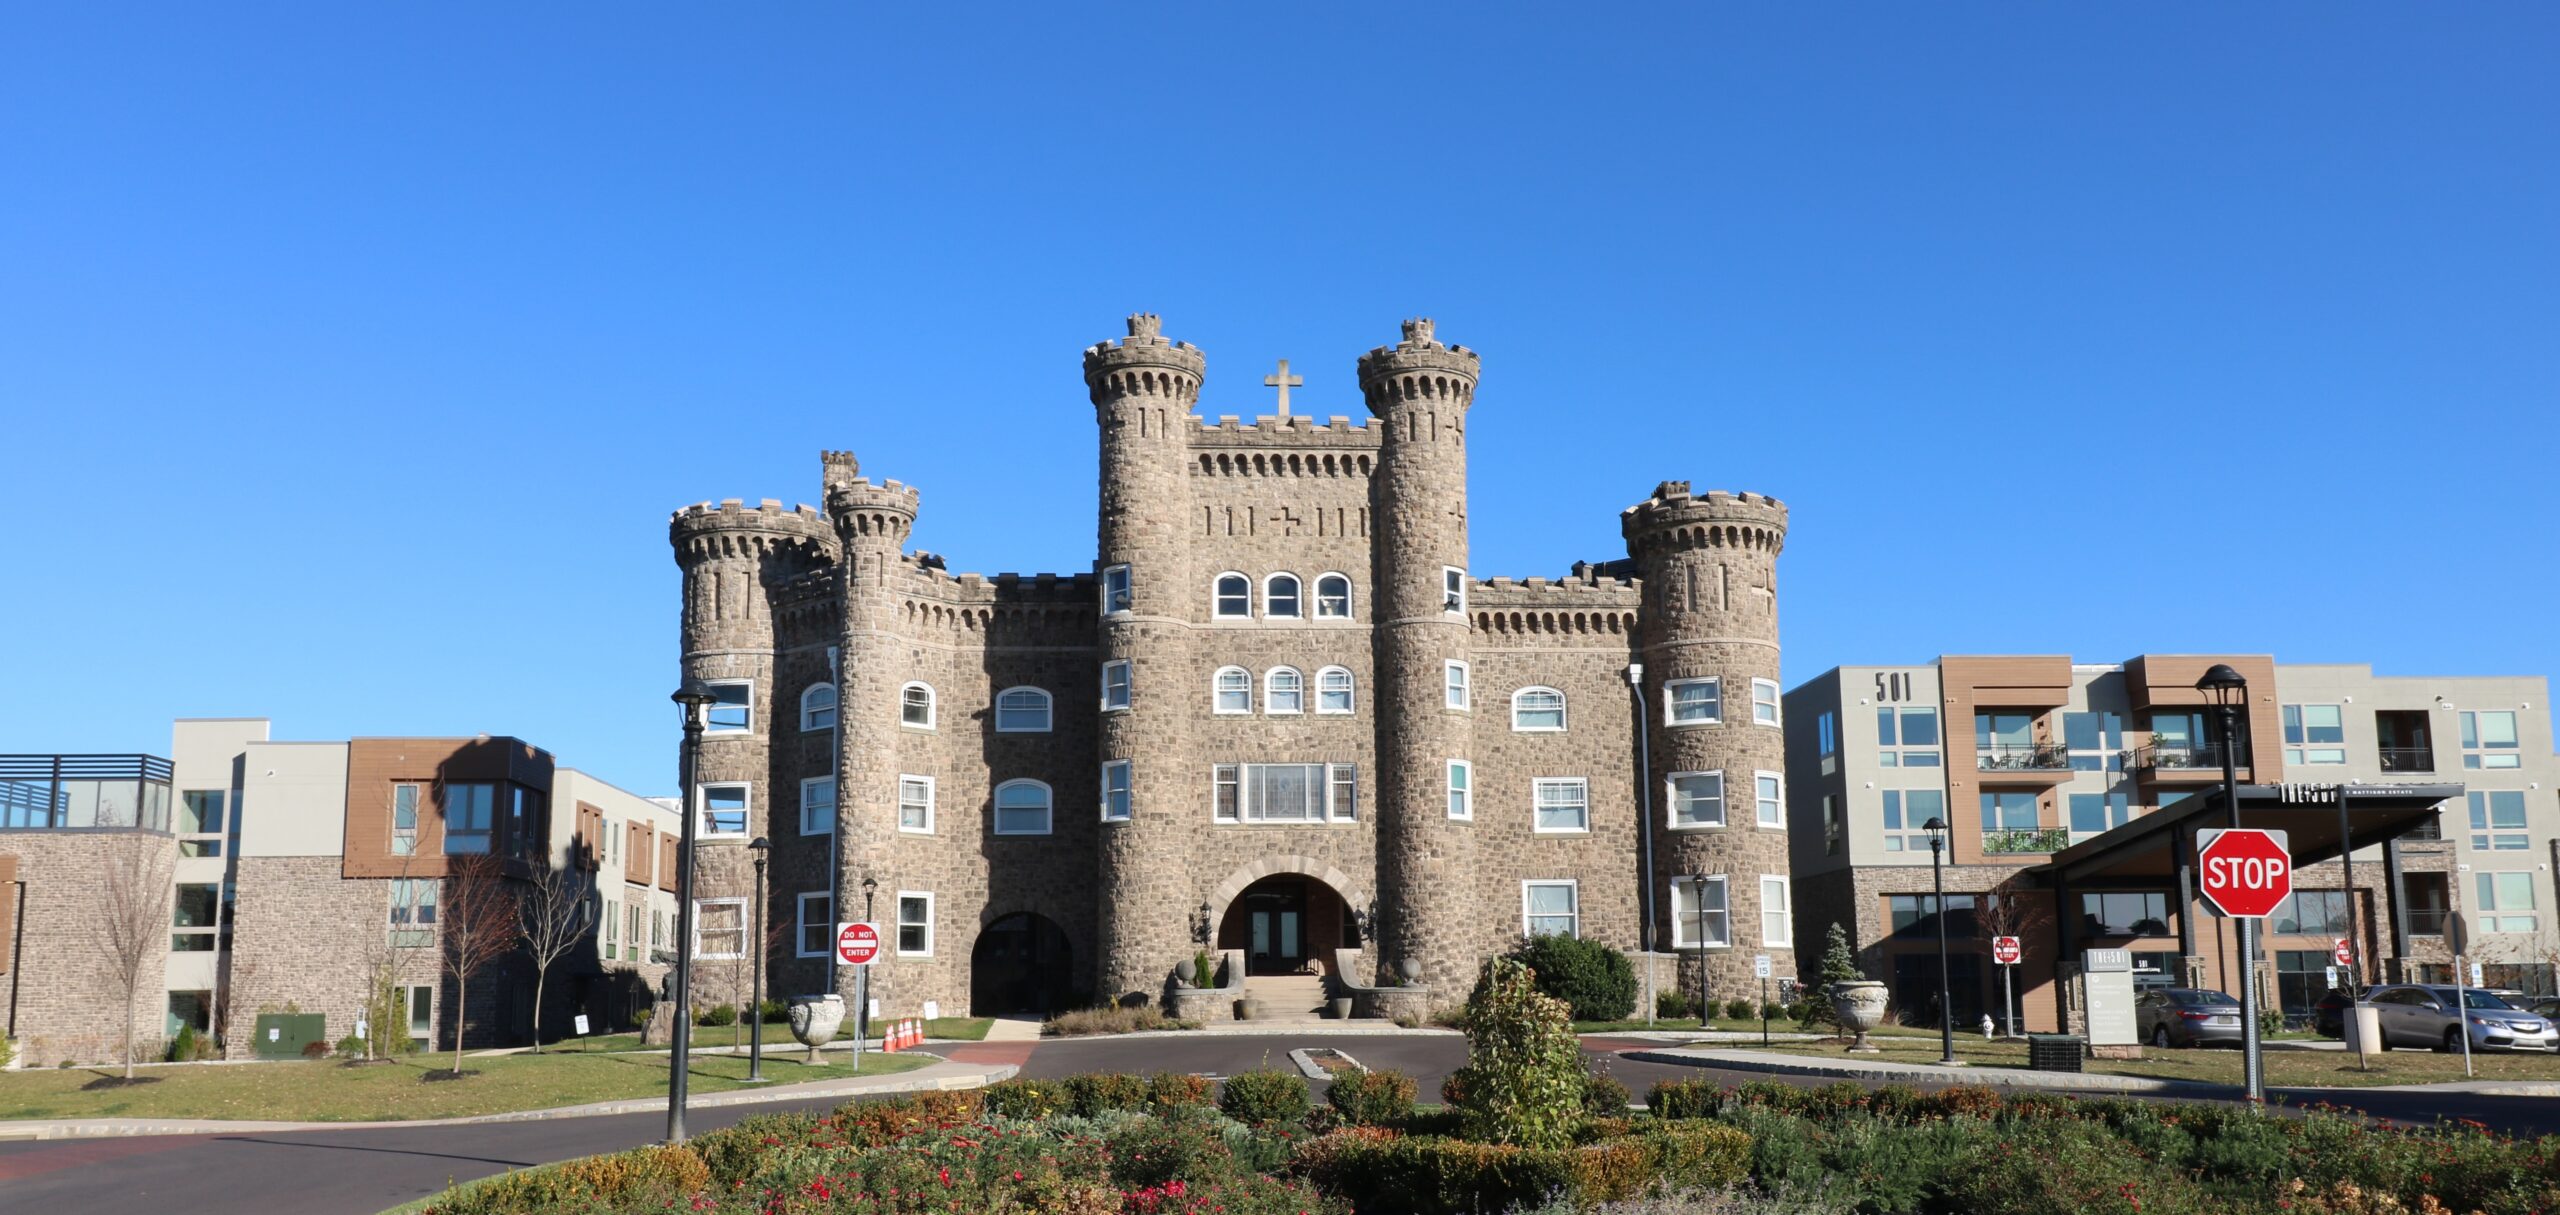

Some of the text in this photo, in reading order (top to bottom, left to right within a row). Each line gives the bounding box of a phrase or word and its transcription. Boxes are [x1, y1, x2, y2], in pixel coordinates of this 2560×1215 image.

[1875, 671, 1911, 702] 501
[2207, 856, 2285, 890] STOP
[844, 931, 873, 939] DO NOT
[846, 949, 870, 957] ENTER
[1758, 967, 1769, 975] 15
